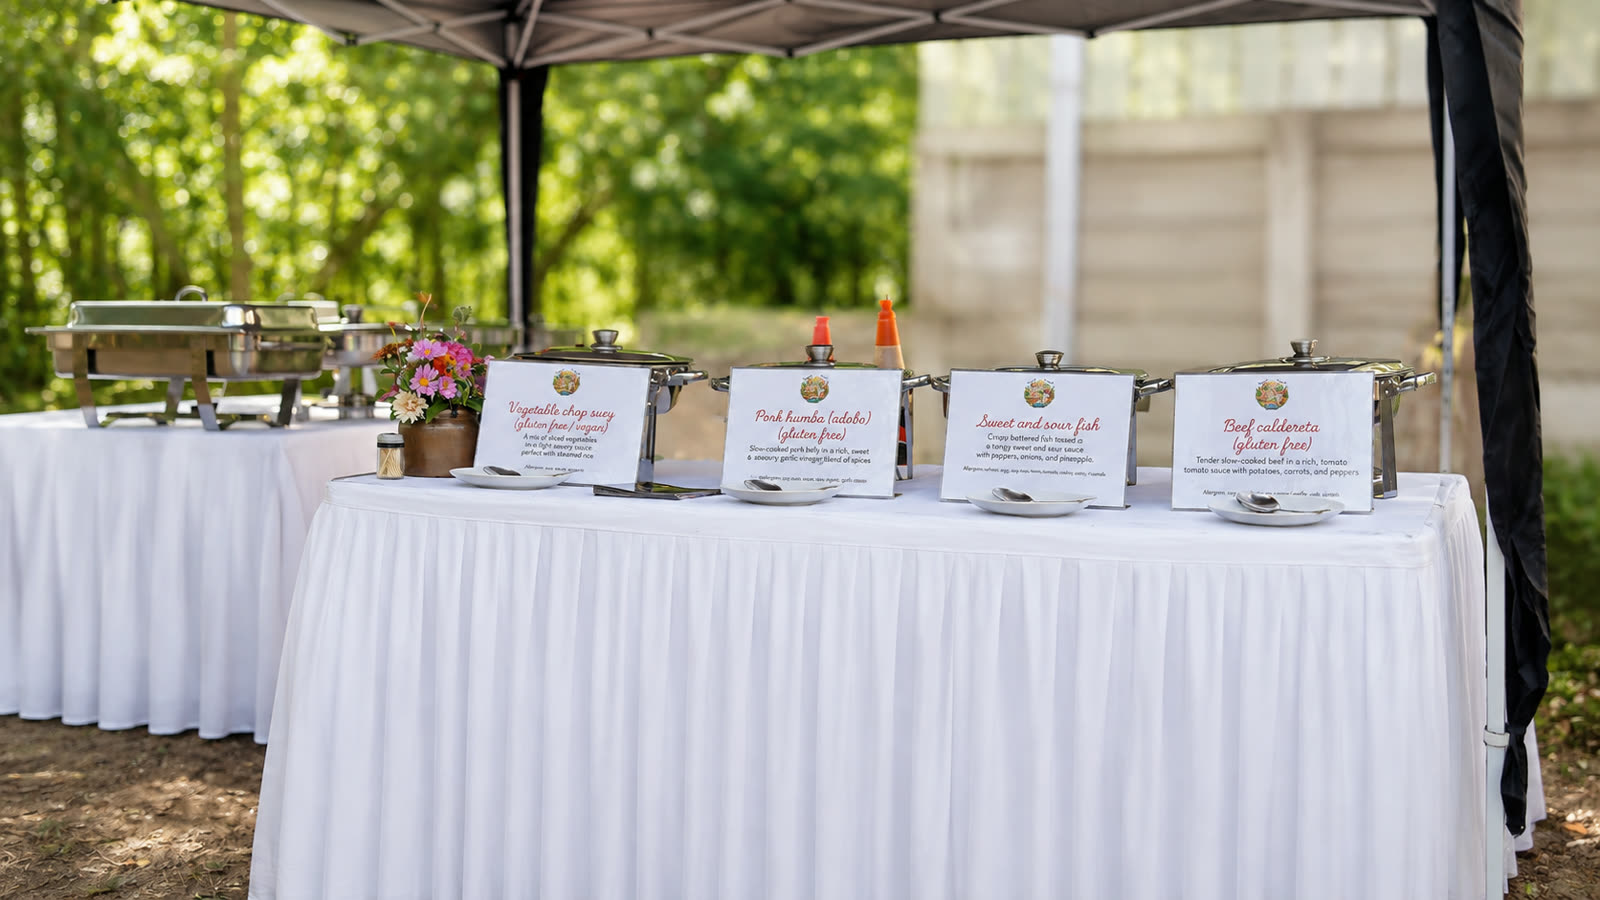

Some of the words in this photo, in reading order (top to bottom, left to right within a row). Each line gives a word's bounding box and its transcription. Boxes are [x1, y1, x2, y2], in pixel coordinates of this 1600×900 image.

[509, 401, 560, 418] Vegetable
[562, 404, 588, 421] chop
[590, 410, 615, 423] suey
[754, 409, 783, 423] Pork
[785, 410, 825, 424] humba
[828, 410, 872, 425] (adobo)
[514, 417, 547, 432] (gluten
[976, 413, 1016, 429] Sweet
[1017, 416, 1042, 430] and
[1044, 420, 1073, 431] sour
[1073, 417, 1101, 436] fish
[1223, 418, 1254, 437] Beef
[1256, 418, 1320, 433] caldereta
[777, 426, 817, 444] (gluten
[817, 427, 847, 445] free)
[1232, 436, 1280, 455] (gluten
[1280, 437, 1313, 456] free)
[1196, 456, 1220, 464] Tender
[1221, 456, 1266, 464] slow-cooked
[1268, 457, 1284, 465] beef
[1302, 458, 1318, 466] rich,
[1330, 469, 1359, 477] peppers
